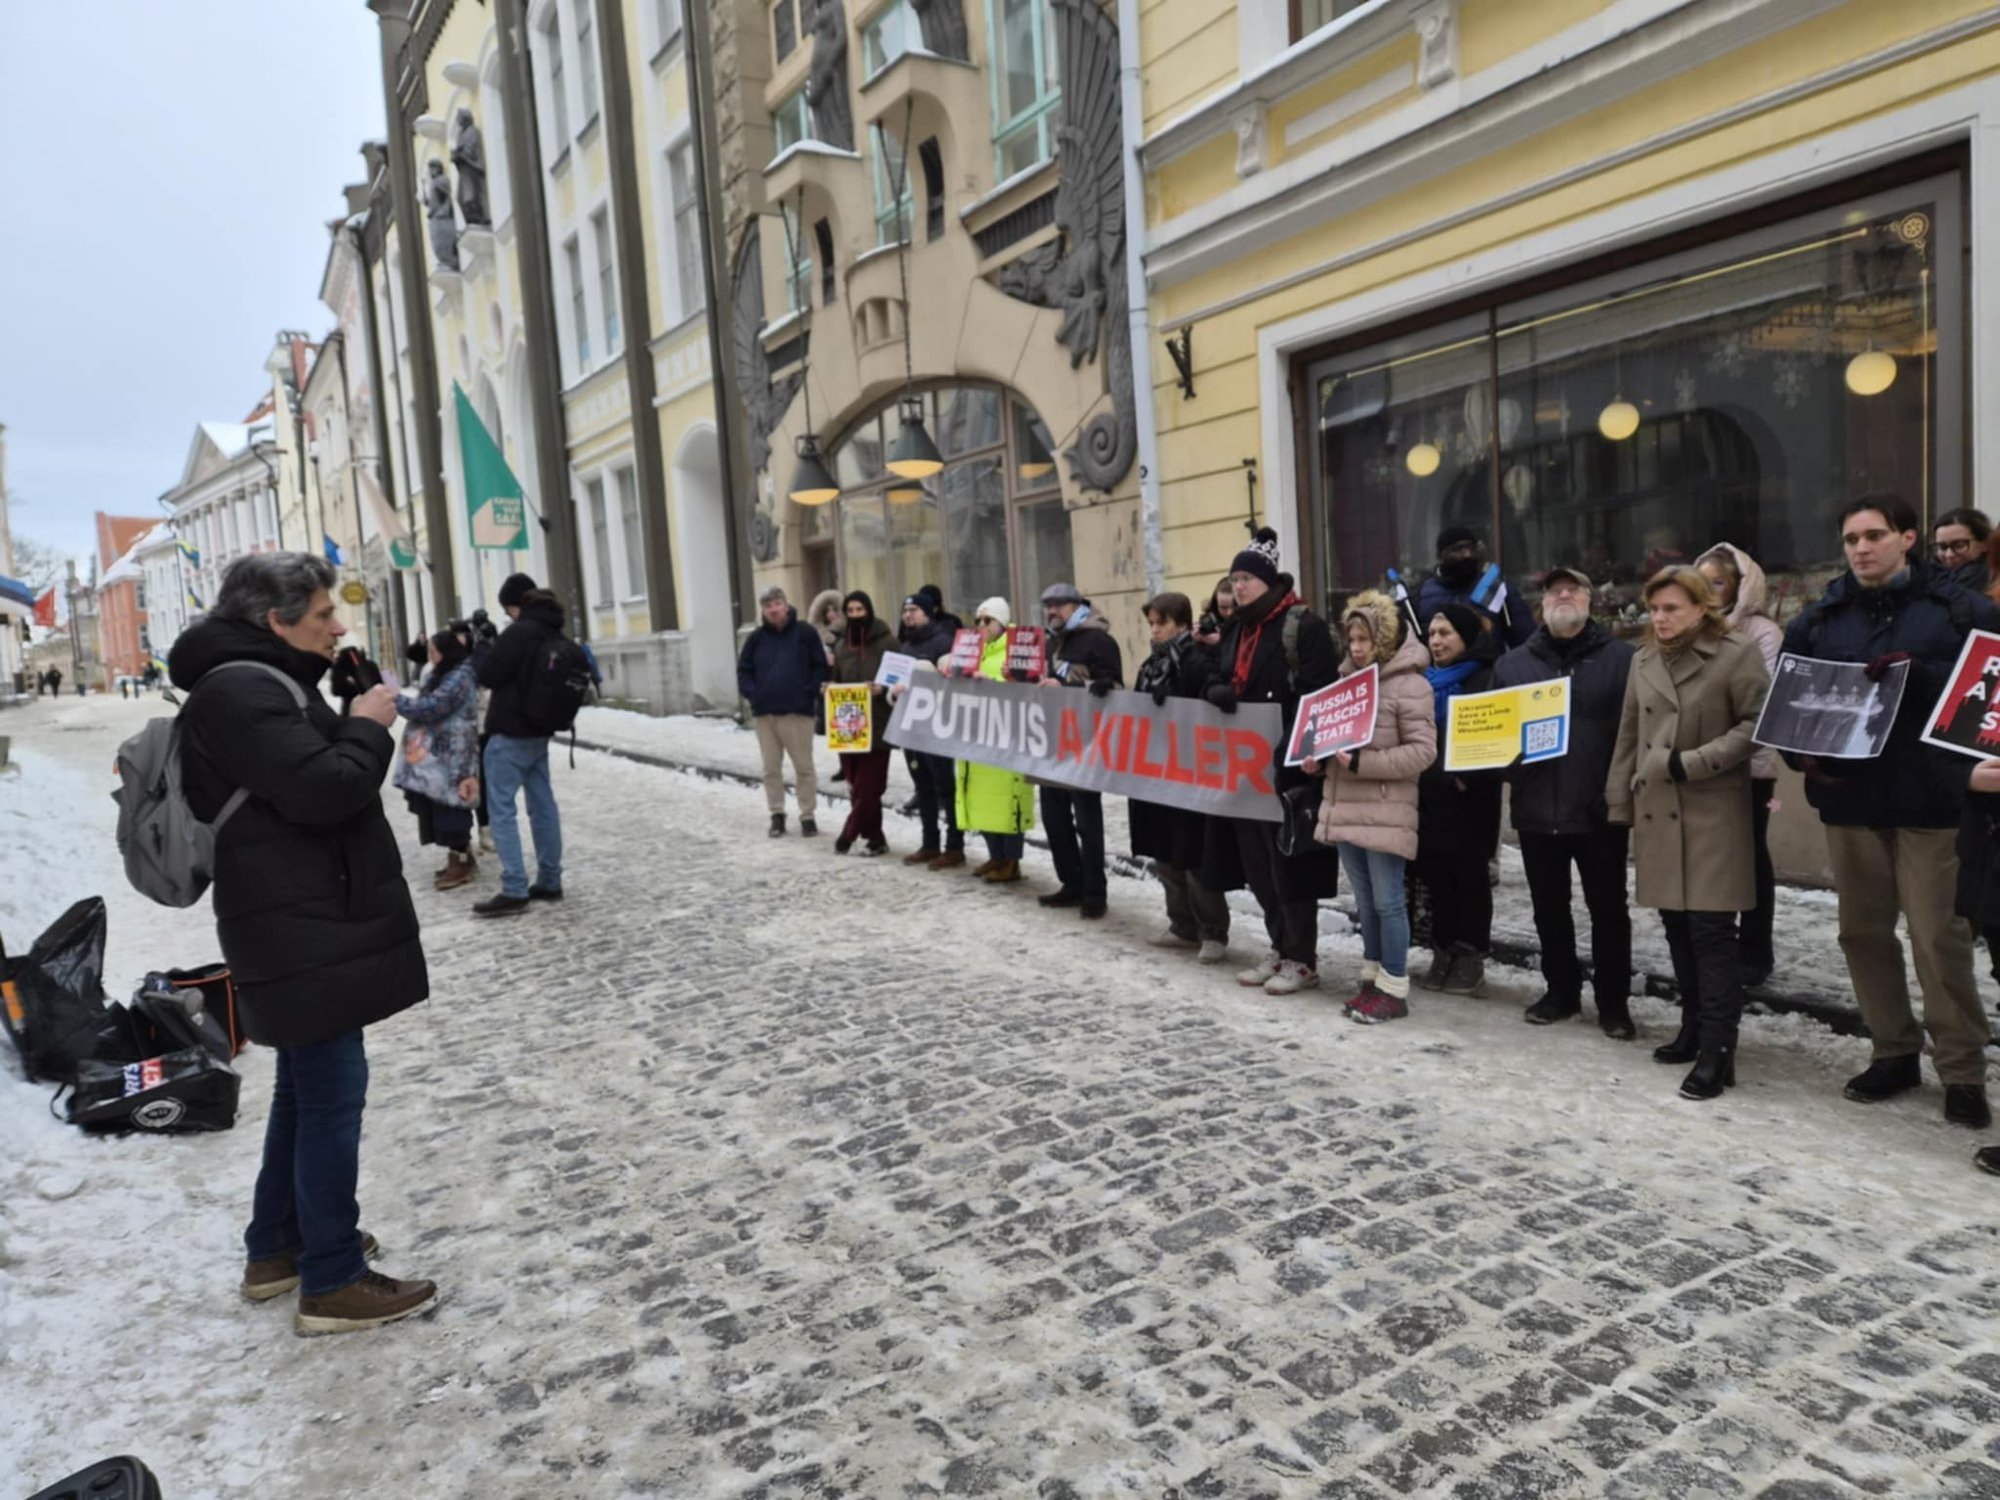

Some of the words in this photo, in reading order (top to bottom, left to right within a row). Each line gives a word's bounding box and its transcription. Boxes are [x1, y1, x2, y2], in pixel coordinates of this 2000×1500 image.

[1309, 689, 1354, 717] RUSSIA
[1356, 682, 1367, 698] IS
[1964, 680, 1986, 701] A
[1303, 720, 1314, 733] A
[1316, 699, 1369, 728] FASCIST
[1313, 721, 1354, 745] STATE
[901, 686, 1011, 749] PUTIN
[1018, 702, 1048, 758] IS
[1056, 707, 1083, 767] A
[1088, 711, 1275, 796] KILLER
